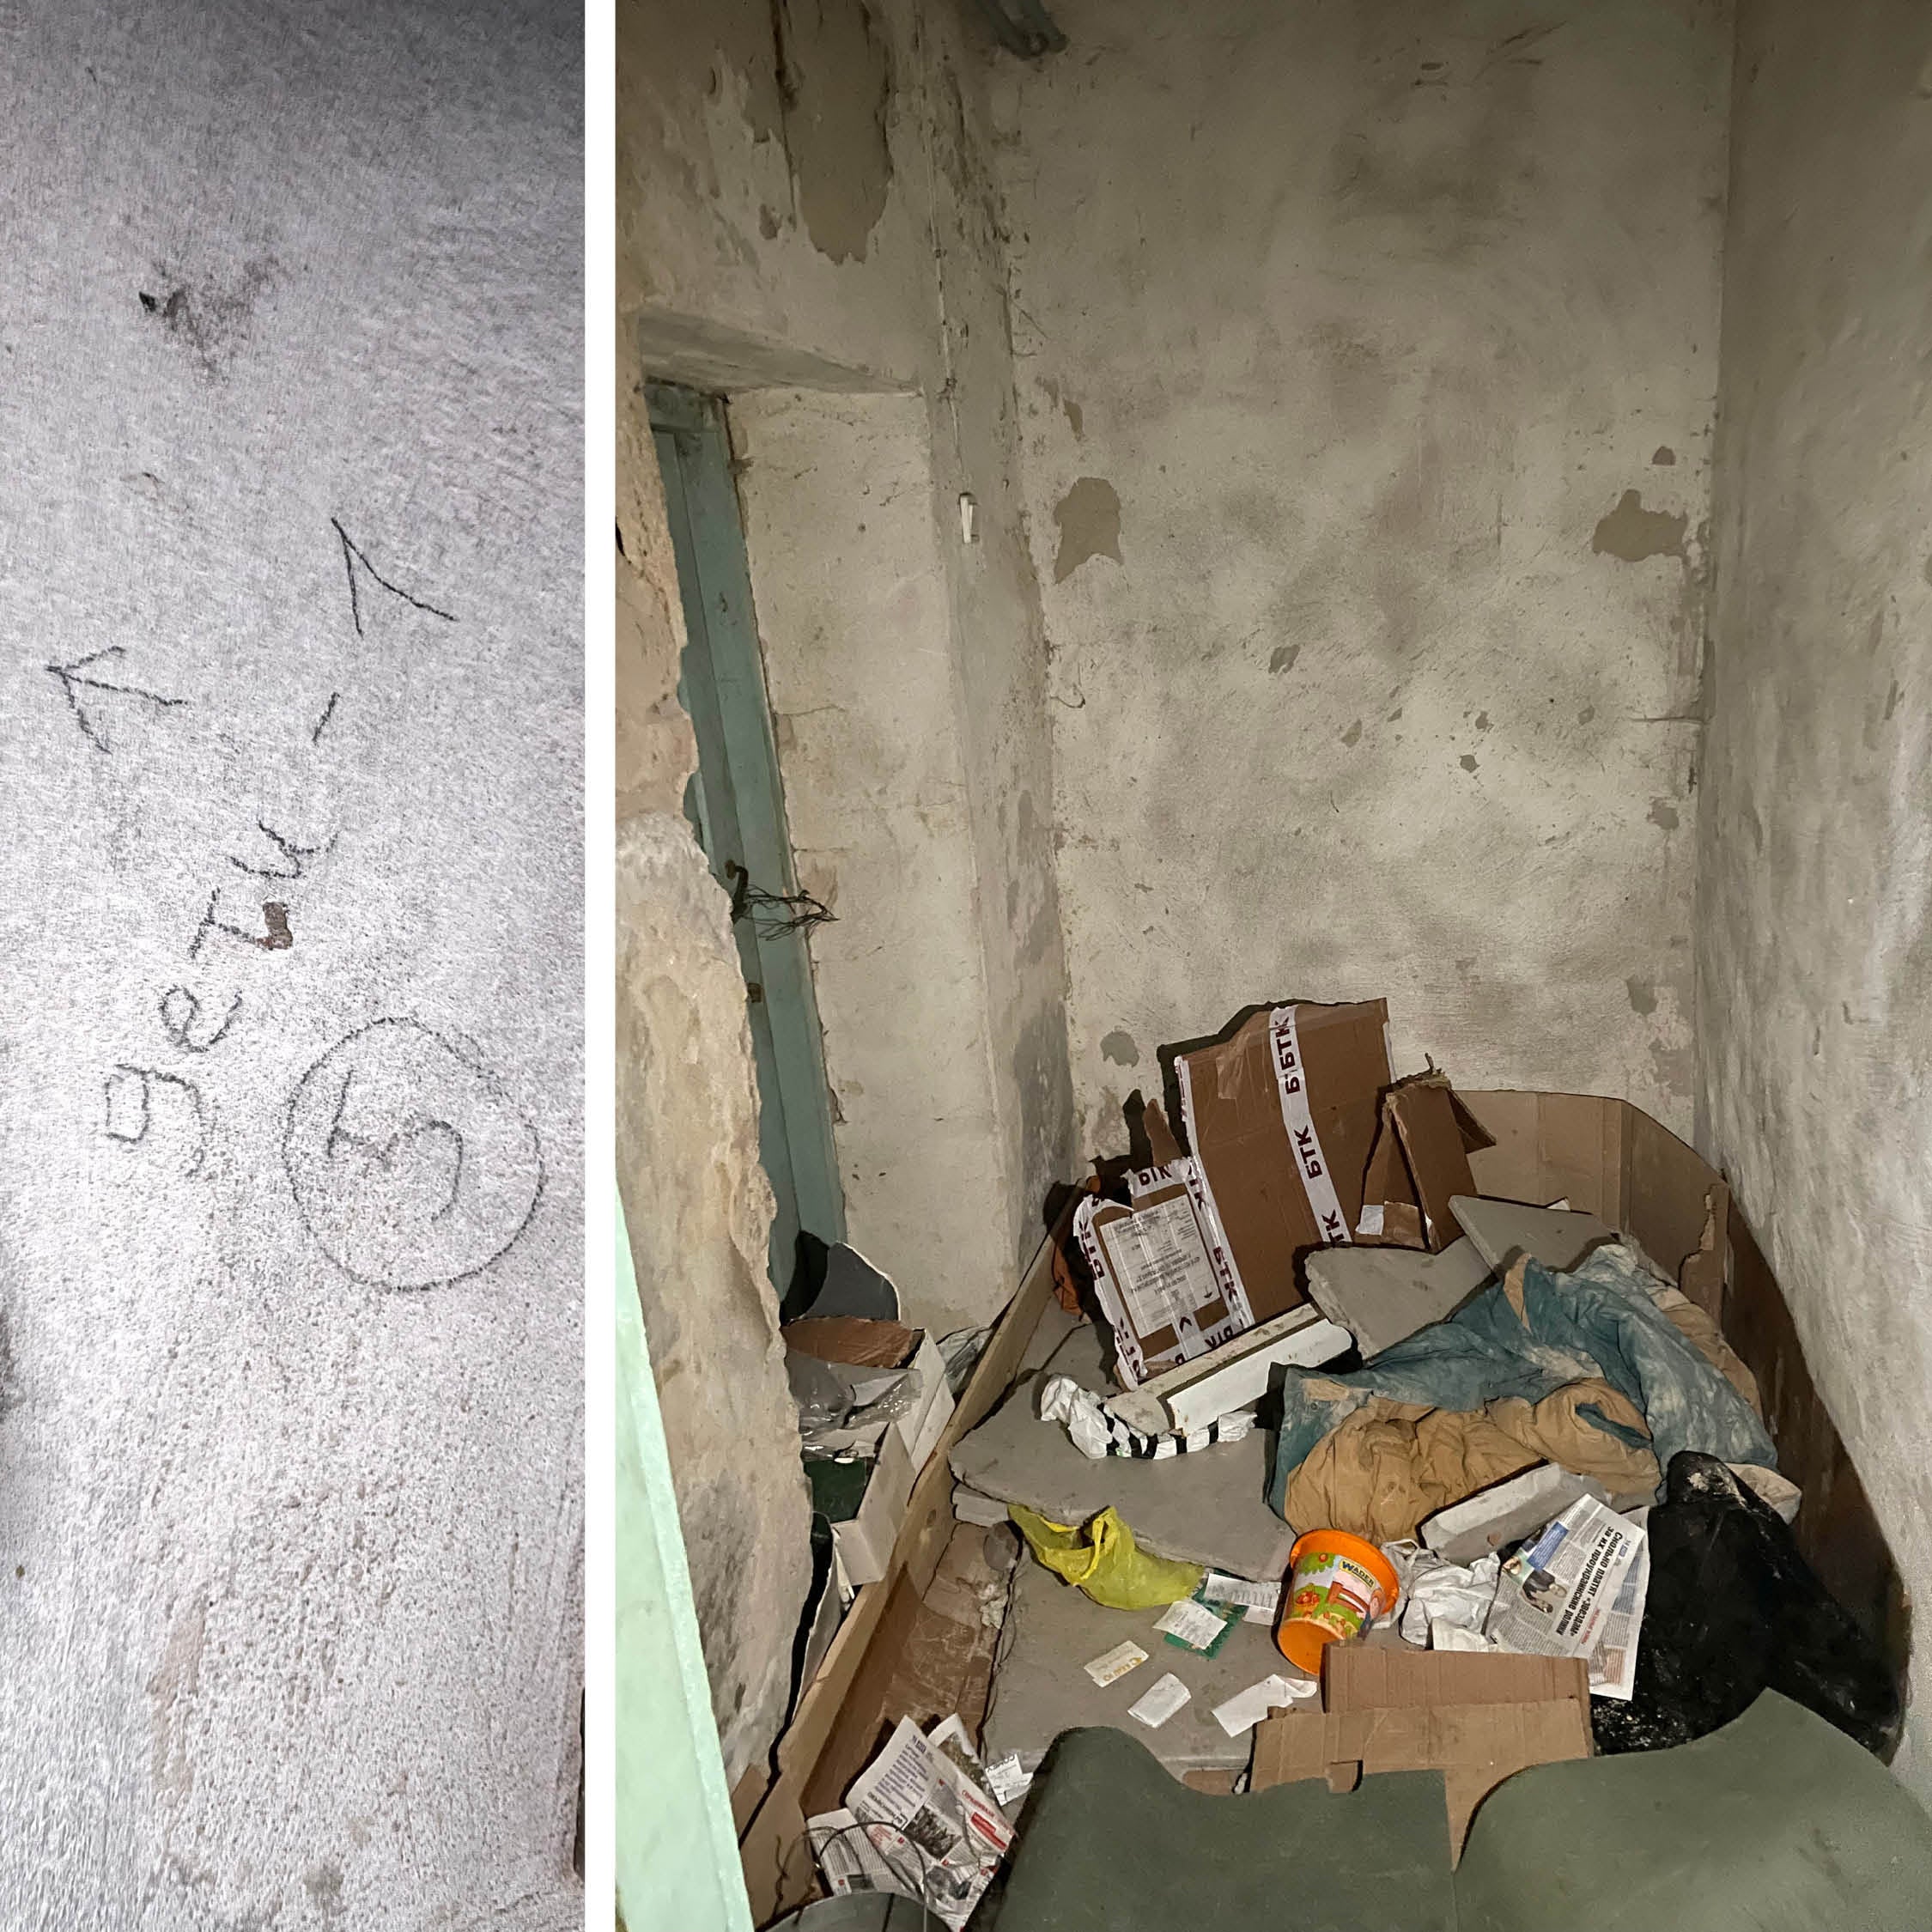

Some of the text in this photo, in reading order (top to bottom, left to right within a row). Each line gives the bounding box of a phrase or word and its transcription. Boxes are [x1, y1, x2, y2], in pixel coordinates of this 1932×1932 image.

[1274, 1016, 1297, 1071] БТК
[1294, 1124, 1323, 1179] БТК
[1321, 1208, 1346, 1244] ТК
[1596, 1536, 1609, 1551] их
[1604, 1526, 1615, 1537] за
[1600, 1531, 1624, 1569] Сколько
[1342, 1560, 1375, 1588] WADER
[1568, 1549, 1601, 1611] проукраинские
[1588, 1567, 1606, 1597] платят
[1555, 1608, 1573, 1636] ролики
